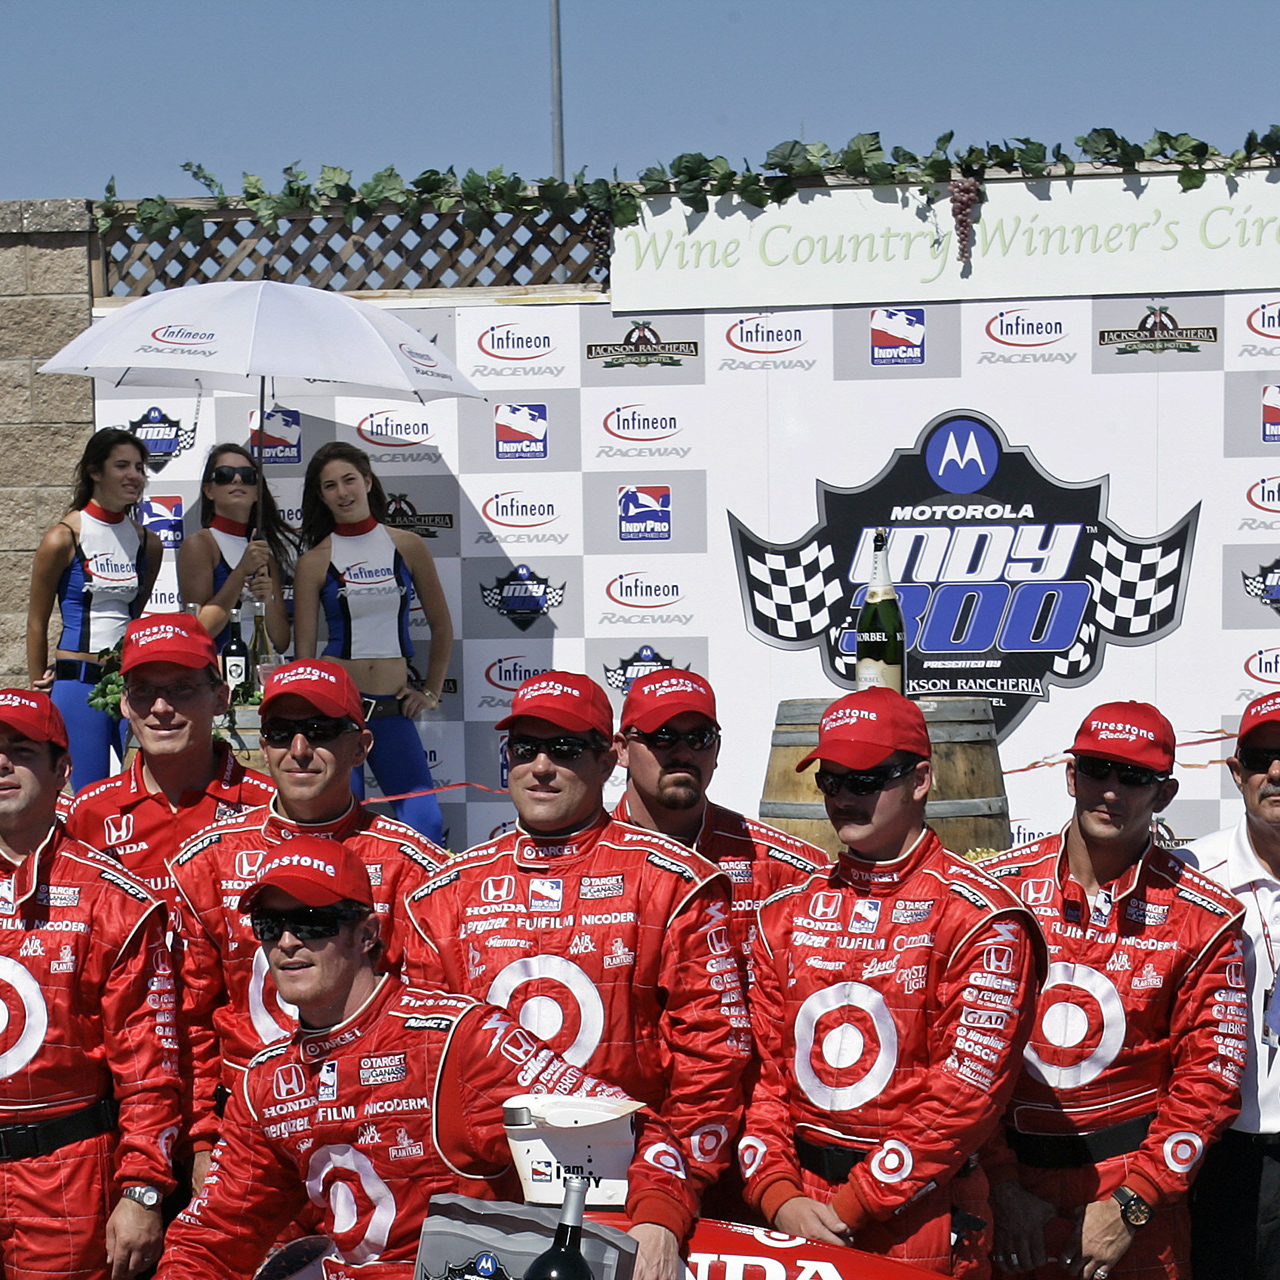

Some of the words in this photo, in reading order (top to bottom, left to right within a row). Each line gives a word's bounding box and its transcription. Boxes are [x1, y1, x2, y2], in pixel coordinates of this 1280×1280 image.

[625, 230, 741, 272] Wine
[759, 224, 955, 284] Country
[975, 208, 1180, 256] Winner's
[738, 316, 802, 341] Infineon
[998, 310, 1062, 335] Infineon
[161, 325, 215, 342] Infineon
[490, 326, 551, 350] Infineon
[135, 345, 218, 358] RACEWAY
[587, 343, 629, 358] JACKSON
[633, 341, 698, 357] RANCHERIA
[718, 358, 816, 372] RACEWAY
[977, 352, 1077, 365] RACEWAY
[470, 365, 565, 378] RACEWAY
[890, 504, 1035, 521] MOTOROLA
[848, 524, 1083, 582] INDY
[349, 560, 393, 581] Infineon
[923, 659, 981, 669] PRESENTED
[984, 659, 1001, 668] BY
[957, 678, 1042, 692] RANCHERIA
[1090, 720, 1155, 742] Firestone
[256, 854, 337, 879] Firestone
[649, 853, 692, 879] IMPACT
[590, 876, 623, 885] TARGET
[466, 903, 527, 916] HONDA
[966, 1011, 1004, 1025] GLAD
[968, 1030, 1006, 1050] Havoline
[955, 1037, 1000, 1062] BOSCH
[371, 1054, 404, 1069] TARGET
[262, 1095, 319, 1118] HONDA
[363, 1097, 428, 1115] NICODERM
